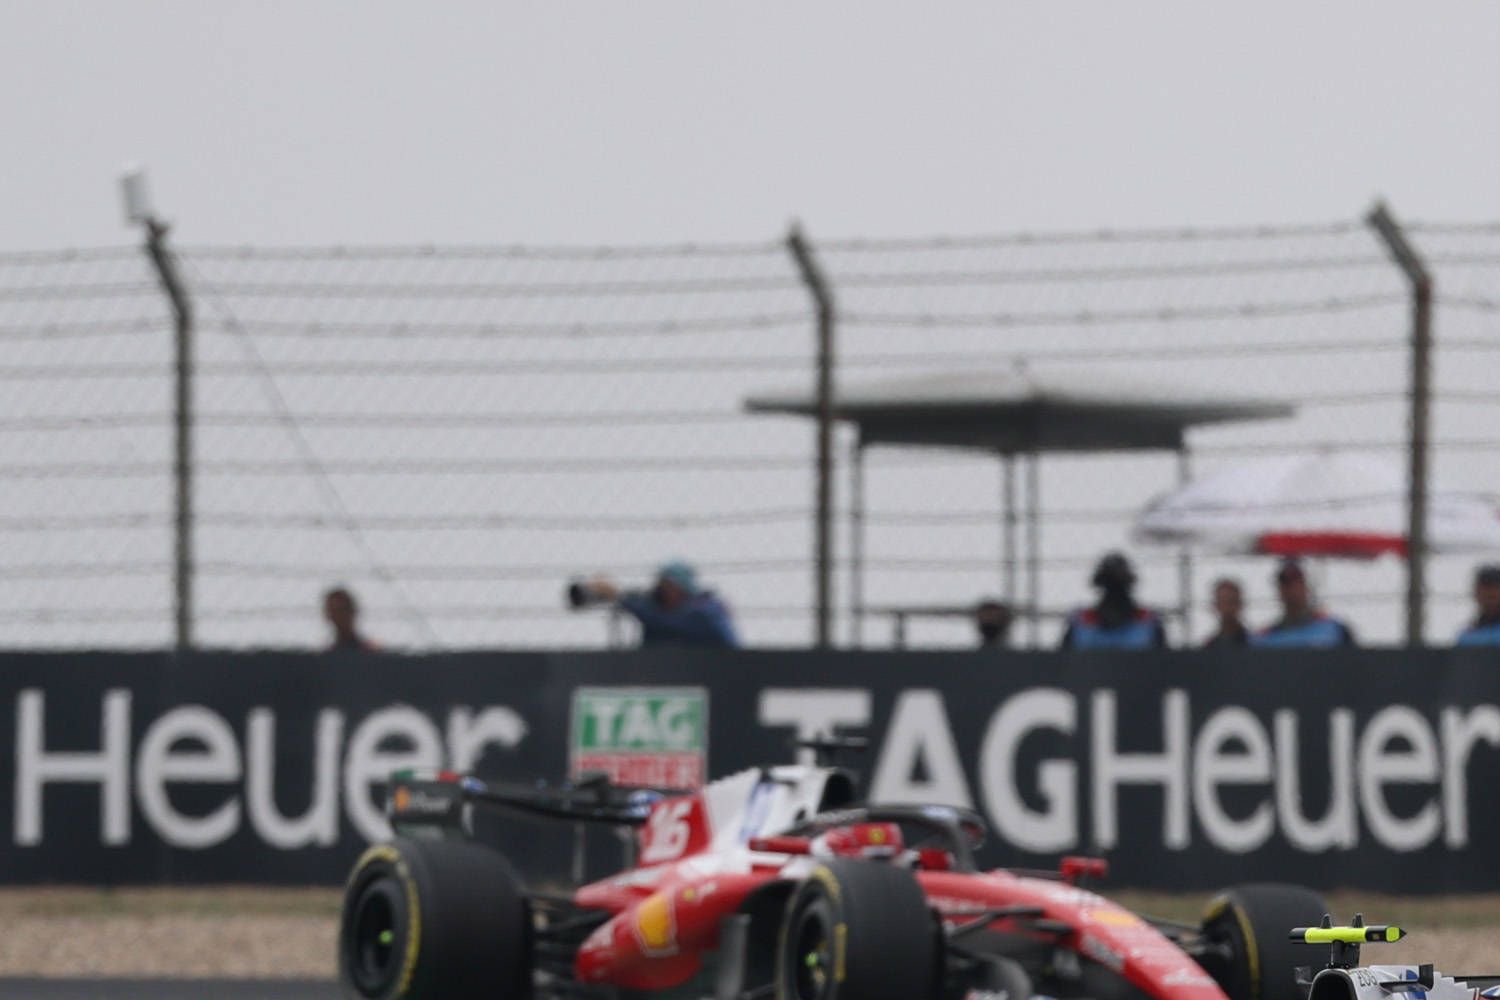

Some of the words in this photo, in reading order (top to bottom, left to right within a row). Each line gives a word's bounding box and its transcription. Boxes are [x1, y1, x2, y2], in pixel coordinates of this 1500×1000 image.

[593, 700, 700, 748] TAG
[14, 689, 527, 849] Heuer
[641, 803, 693, 859] 16
